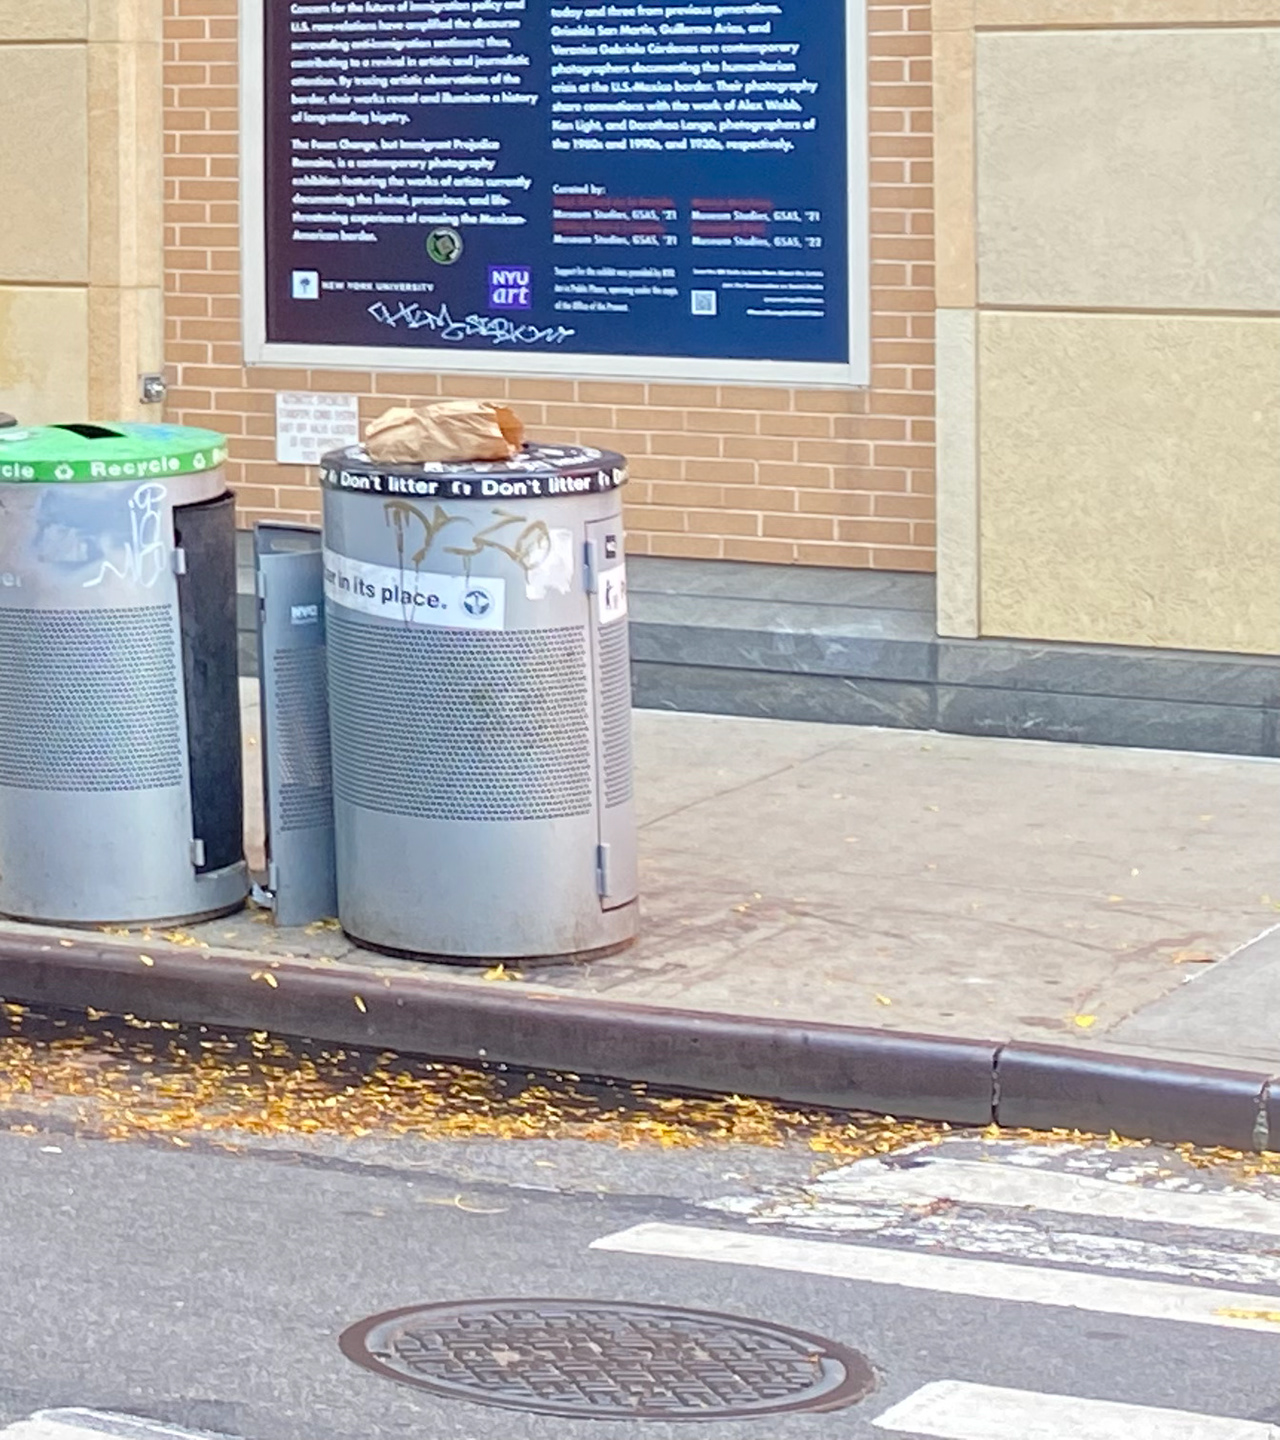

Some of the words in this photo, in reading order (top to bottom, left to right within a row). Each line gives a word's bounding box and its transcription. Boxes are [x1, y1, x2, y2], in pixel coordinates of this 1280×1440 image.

[553, 184, 588, 194] Curated
[591, 184, 605, 195] by:
[553, 209, 590, 218] Museum
[594, 209, 628, 220] Studies,
[691, 210, 730, 220] Museum
[734, 210, 769, 221] Studies,
[293, 229, 338, 240] American
[553, 234, 591, 243] Museum
[594, 234, 628, 245] Studies,
[692, 236, 731, 245] Museum
[734, 235, 769, 247] Studies,
[492, 270, 529, 286] NYU
[321, 280, 345, 291] NEW
[347, 282, 372, 290] YORK
[376, 282, 432, 291] UNIVERSITY
[492, 286, 529, 305] art
[90, 457, 181, 477] Recycle
[340, 471, 383, 491] Don't
[389, 476, 440, 494] litter
[481, 479, 541, 496] Don't
[548, 477, 591, 494] litter
[338, 570, 351, 592] in
[353, 578, 376, 599] its
[381, 583, 448, 610] place.
